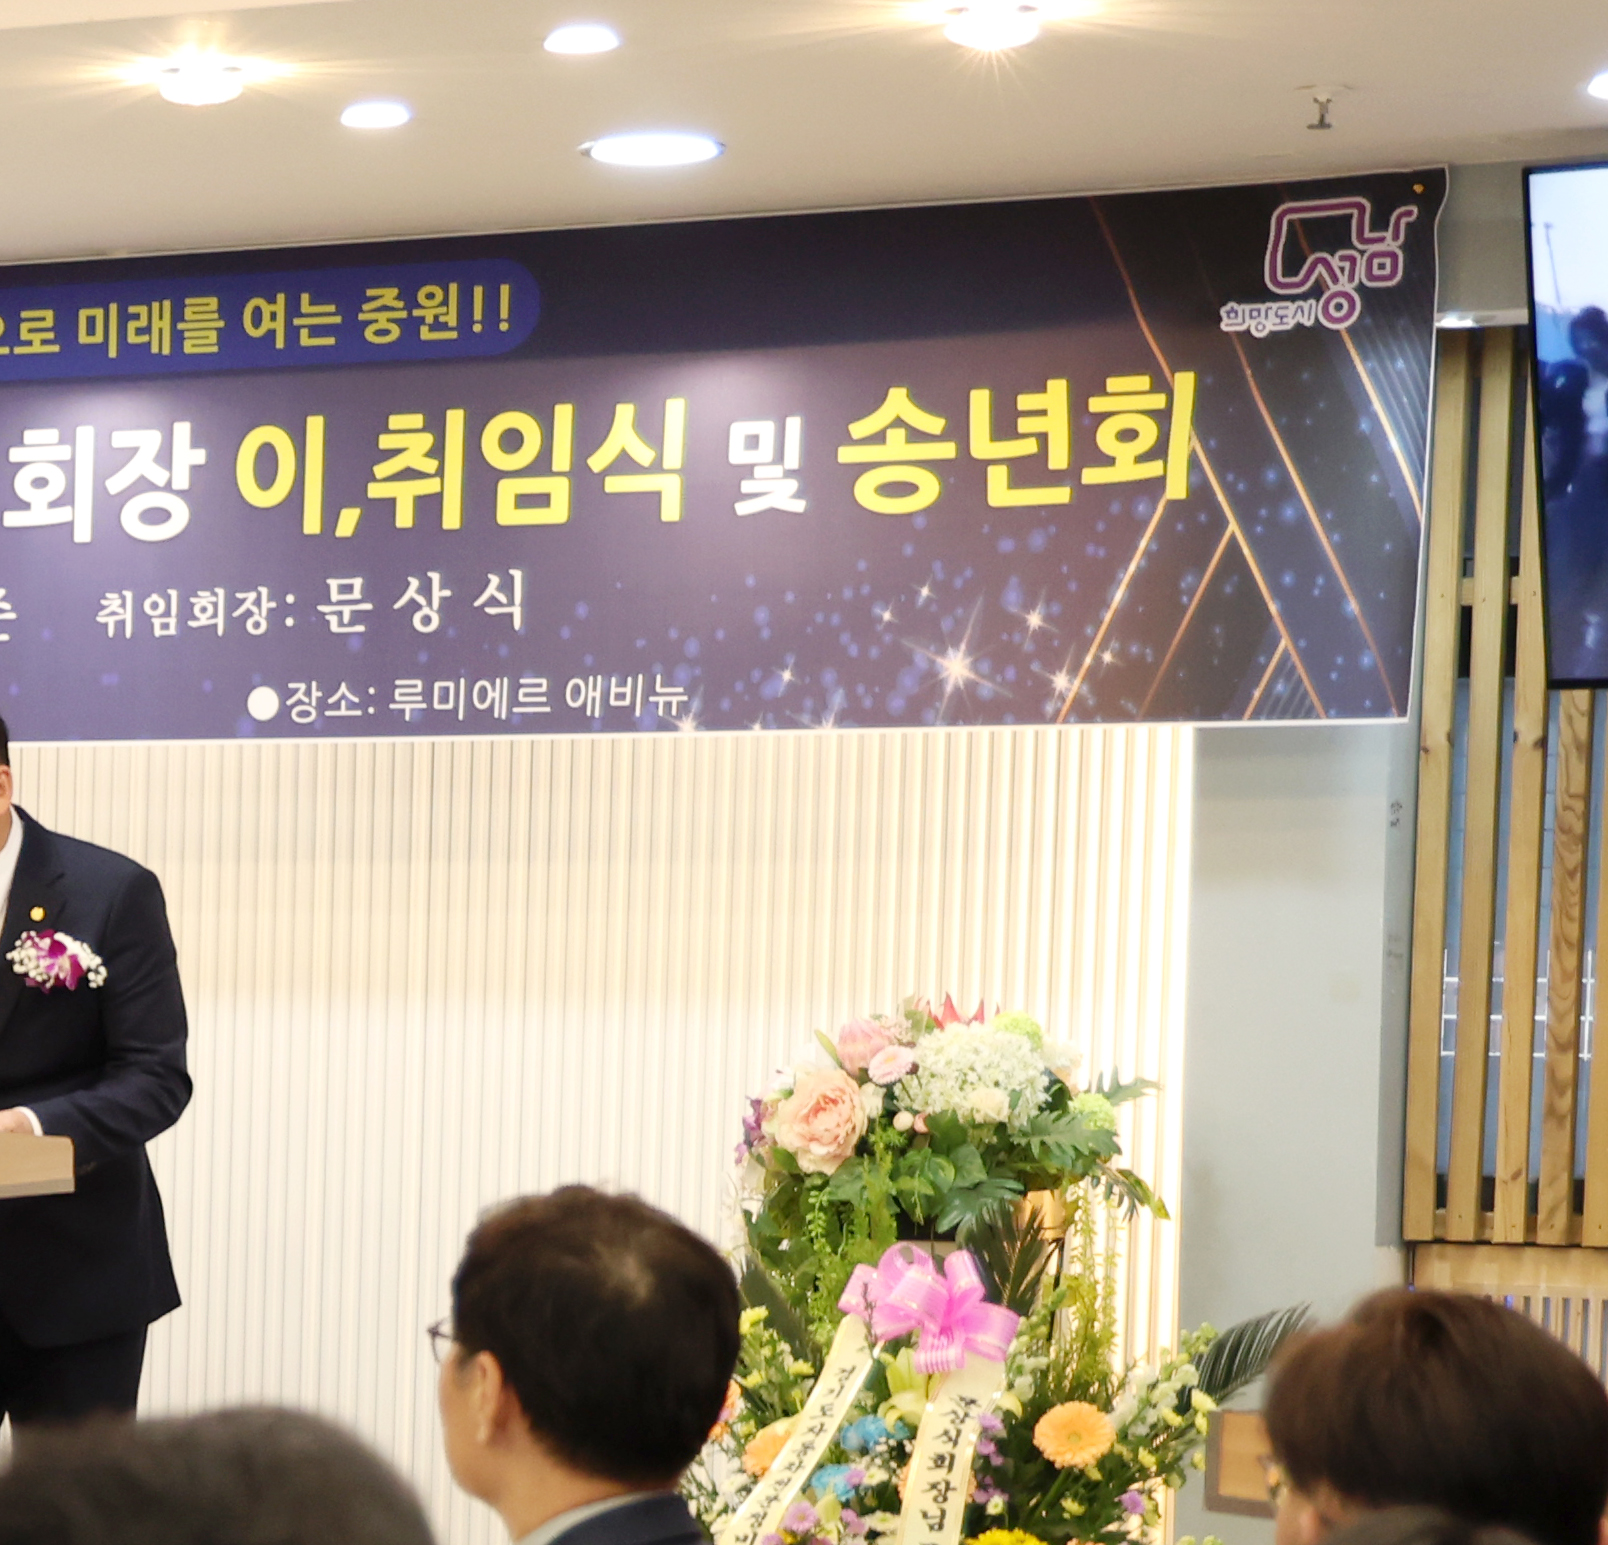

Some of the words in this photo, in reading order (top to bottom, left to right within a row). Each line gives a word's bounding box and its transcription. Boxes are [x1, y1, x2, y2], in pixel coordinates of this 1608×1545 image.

[77, 296, 227, 357] 미래를
[242, 291, 343, 348] 여는
[358, 282, 512, 342] 중원!!
[1220, 301, 1317, 338] 희망도시
[2, 421, 207, 543] 회장
[234, 397, 687, 540] 이,취임식
[726, 414, 808, 517] 및
[837, 370, 1200, 515] 송년회
[94, 585, 296, 641] 취임회장:
[387, 676, 553, 723] 루미에르
[564, 672, 691, 721] 애비뉴
